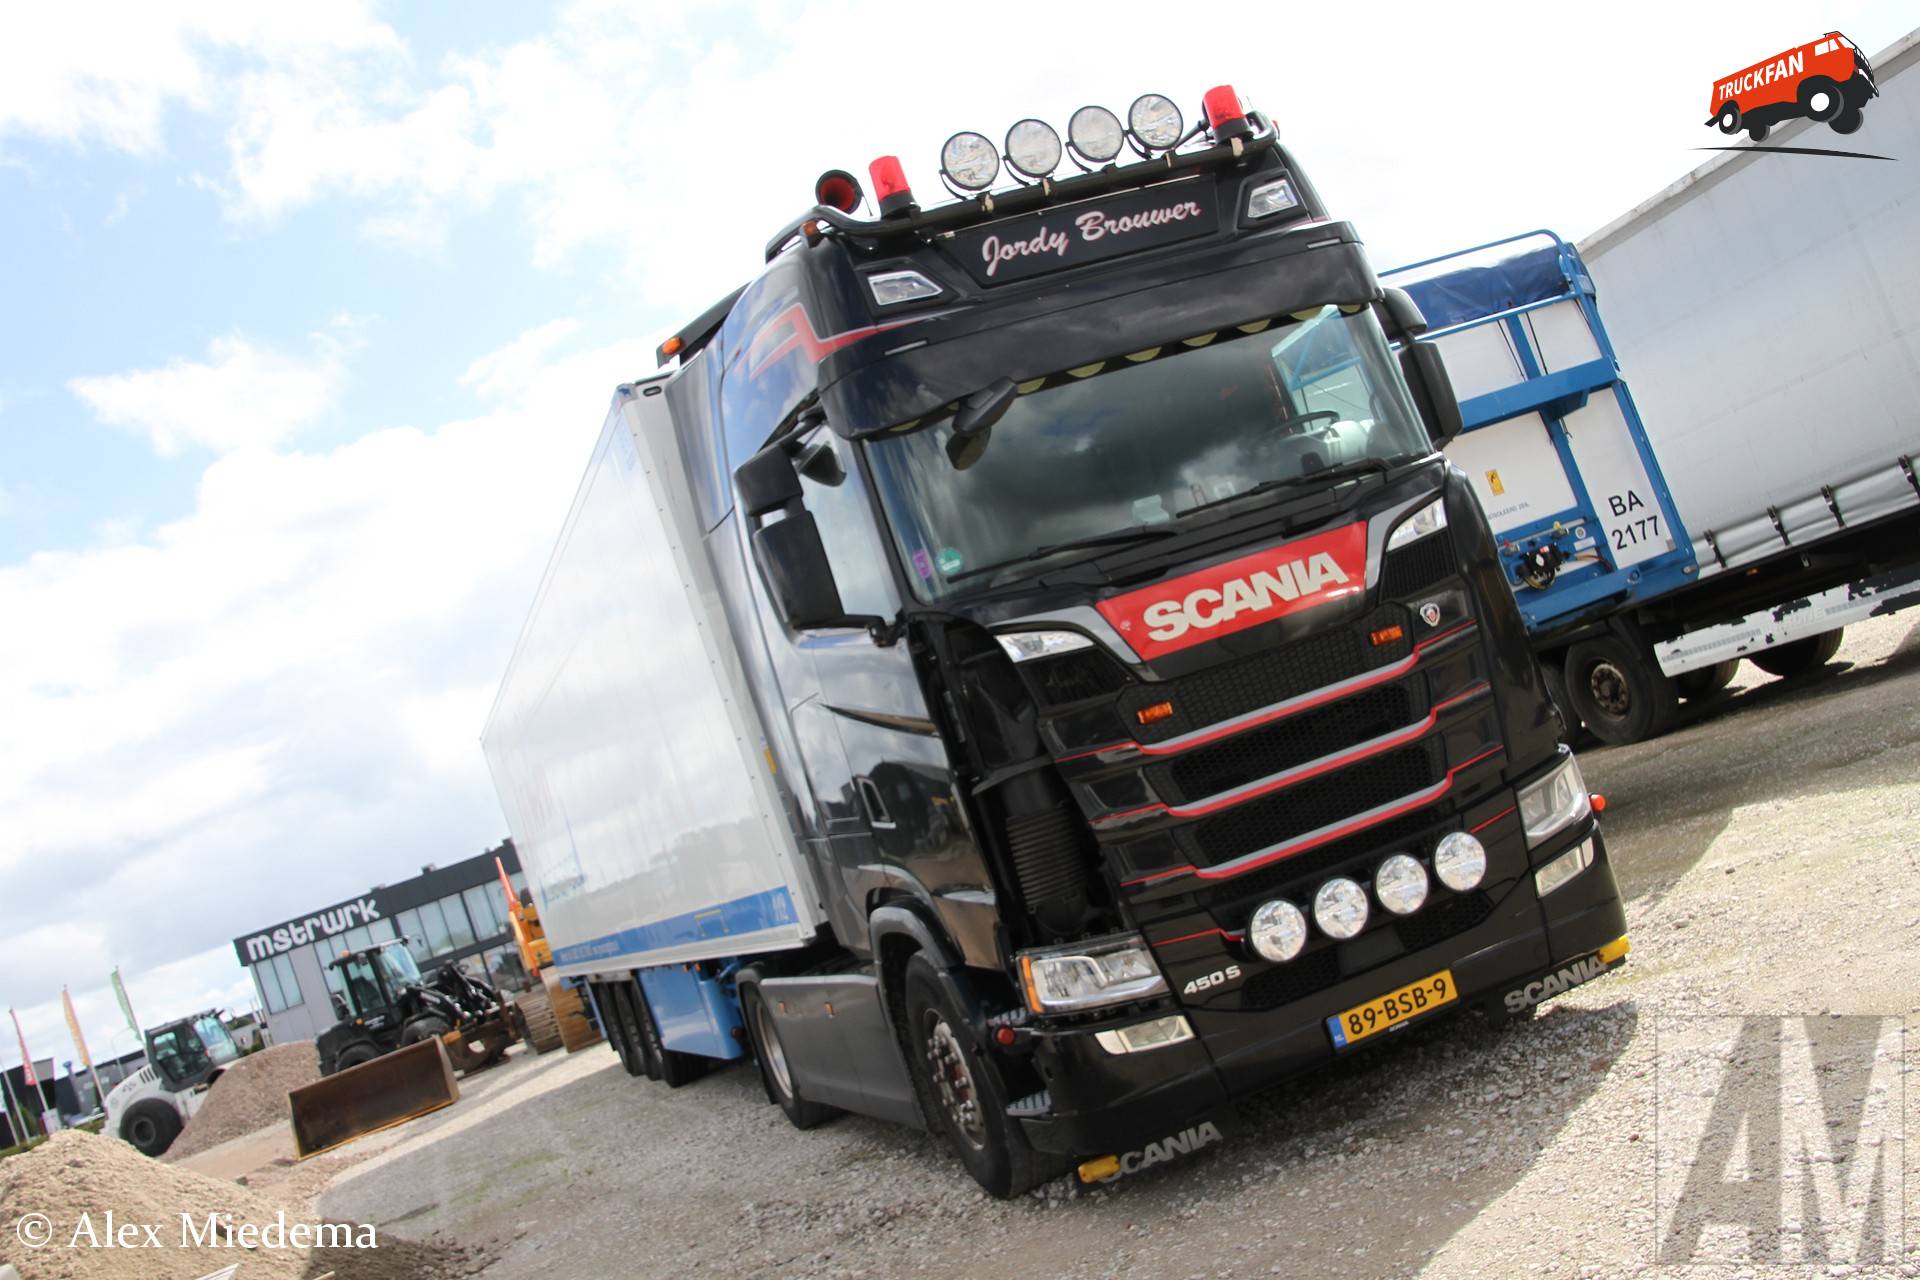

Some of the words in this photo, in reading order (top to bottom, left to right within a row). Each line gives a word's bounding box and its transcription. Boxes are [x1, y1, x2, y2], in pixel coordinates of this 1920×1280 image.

[981, 226, 1069, 277] Jordy
[1075, 200, 1201, 242] Brouwer
[1608, 490, 1644, 517] BA
[1612, 515, 1659, 551] 2177
[1143, 551, 1349, 642] SCANIA
[246, 898, 380, 962] mstrwrk
[1183, 971, 1225, 995] 450
[1225, 965, 1241, 980] S
[1347, 978, 1447, 1035] 89-BSB-9
[1503, 955, 1608, 1015] SCANIA
[1098, 1121, 1224, 1184] CANIA
